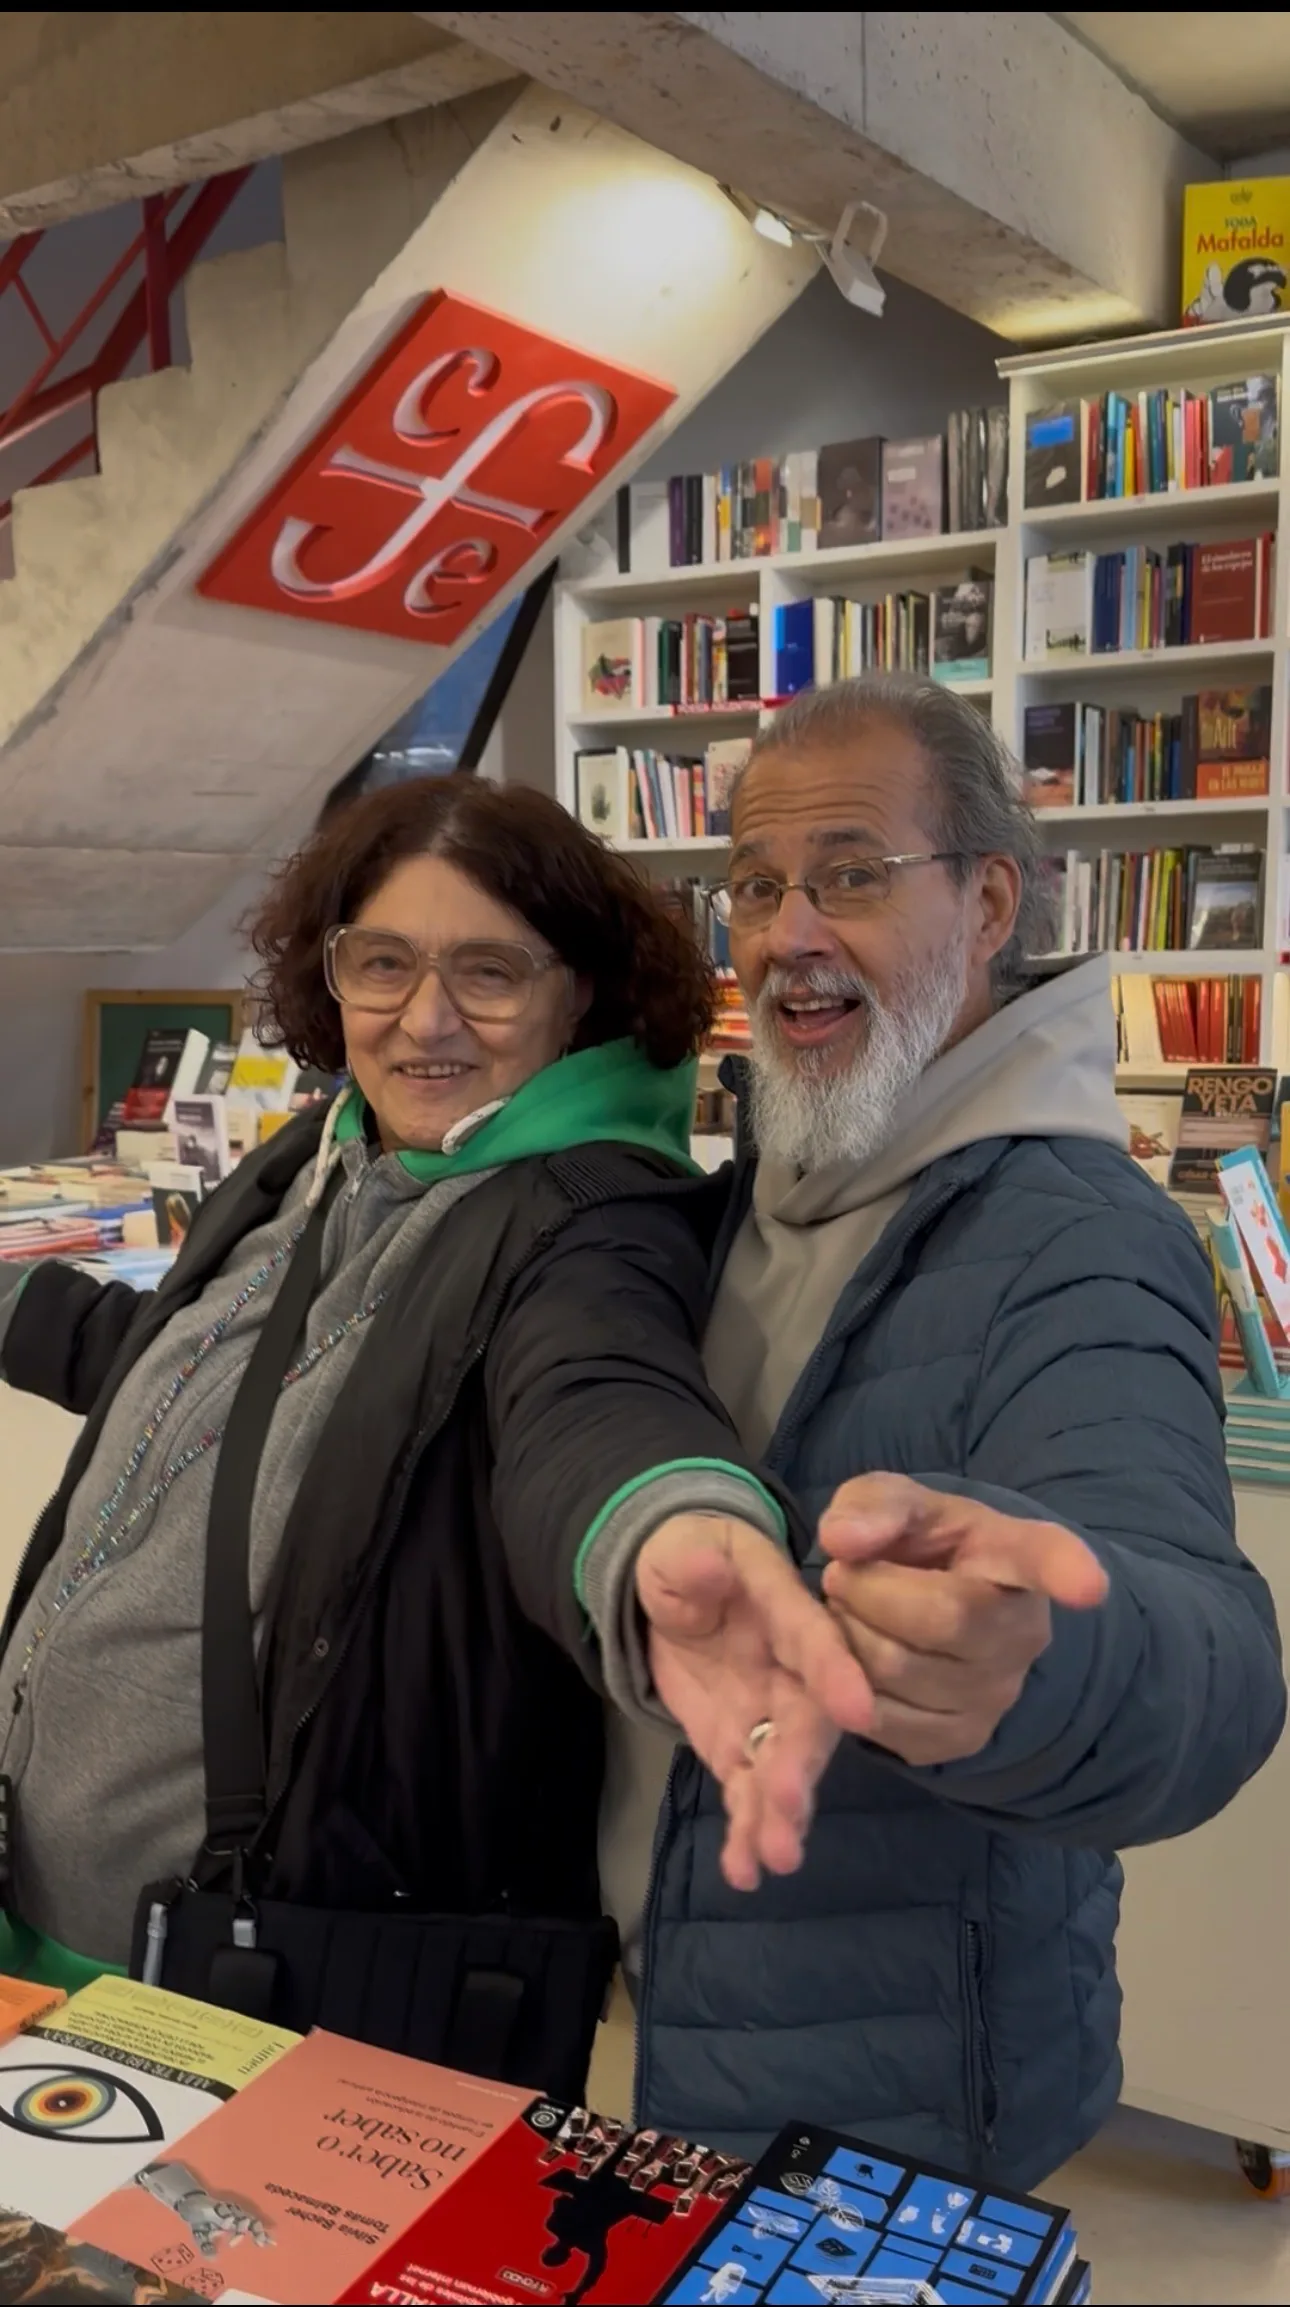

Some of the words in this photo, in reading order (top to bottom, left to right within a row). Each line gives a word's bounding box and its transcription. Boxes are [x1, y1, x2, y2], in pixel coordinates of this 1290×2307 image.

[1196, 227, 1284, 254] Mafalda
[1187, 1076, 1273, 1095] RENGO
[1199, 1093, 1257, 1114] YETA
[323, 2107, 421, 2146] saber
[315, 2134, 340, 2151] o
[420, 2137, 467, 2162] no
[338, 2144, 443, 2191] Saber
[339, 2222, 380, 2246] Silvia
